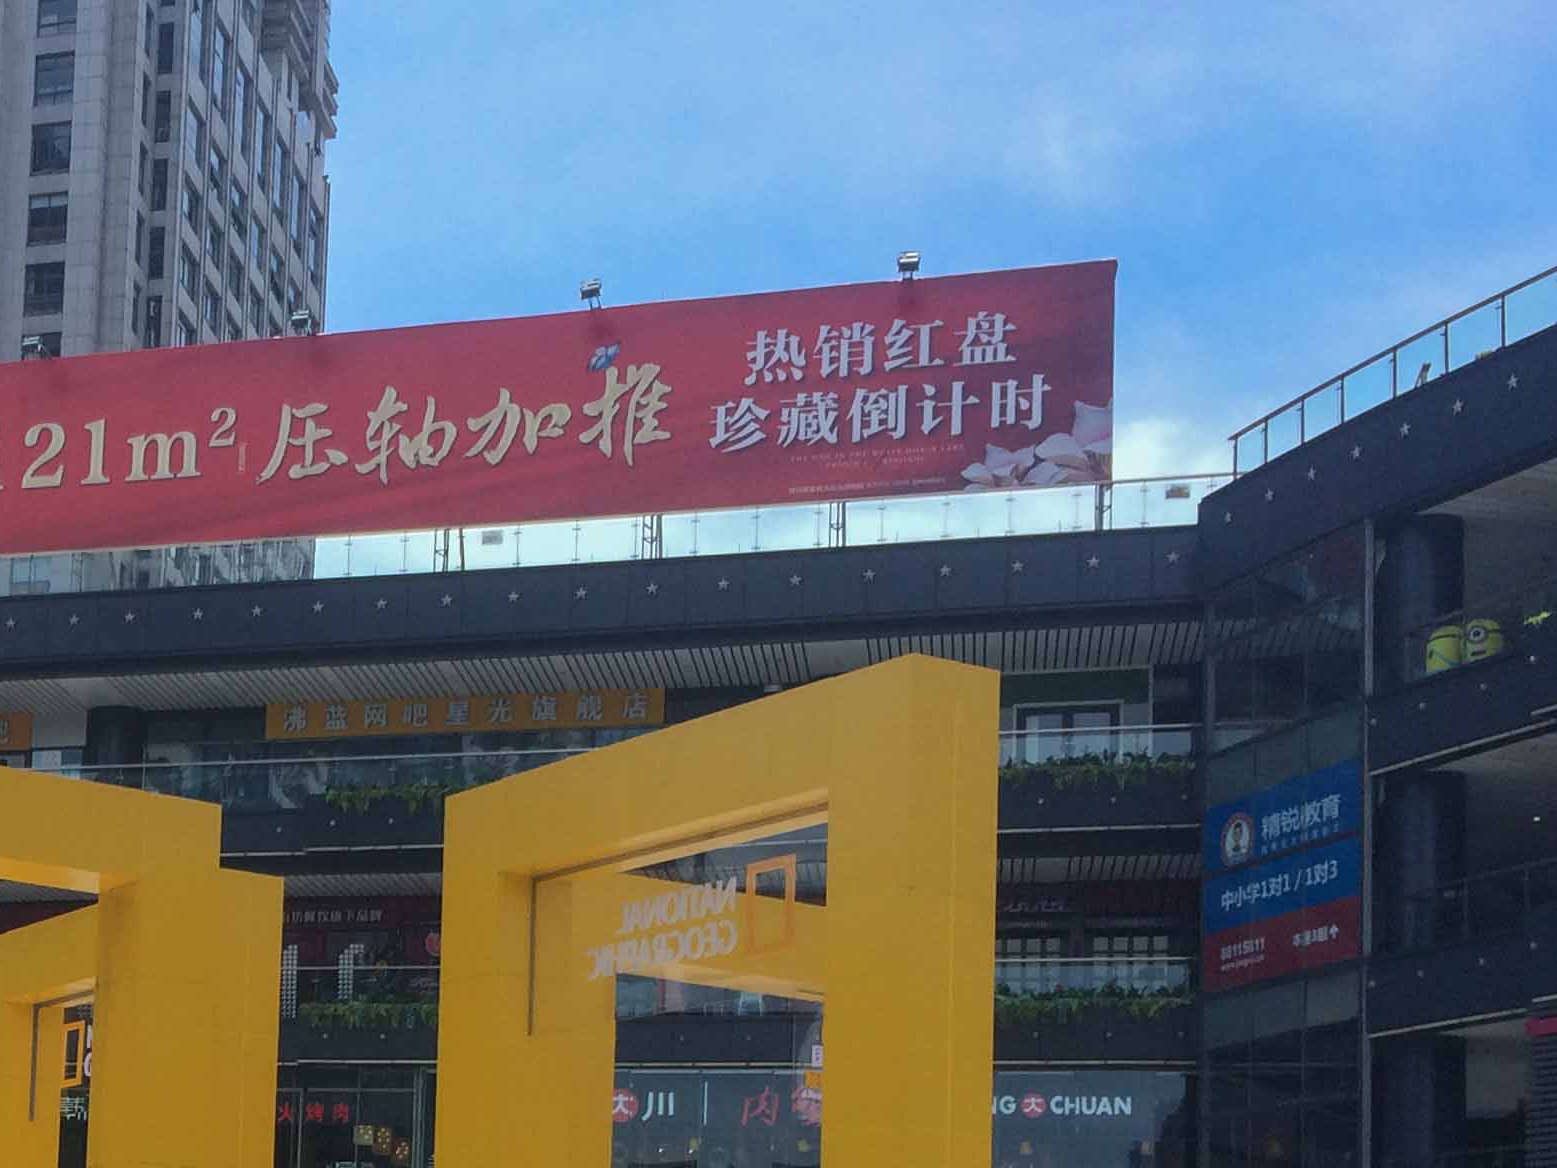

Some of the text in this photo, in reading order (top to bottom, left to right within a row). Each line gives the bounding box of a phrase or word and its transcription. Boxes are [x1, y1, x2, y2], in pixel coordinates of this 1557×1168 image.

[744, 311, 1017, 385] 热销红盘
[255, 363, 672, 486] 压轴加推
[708, 373, 1052, 453] 珍藏倒计时
[1050, 1096, 1132, 1115] CHUAN
